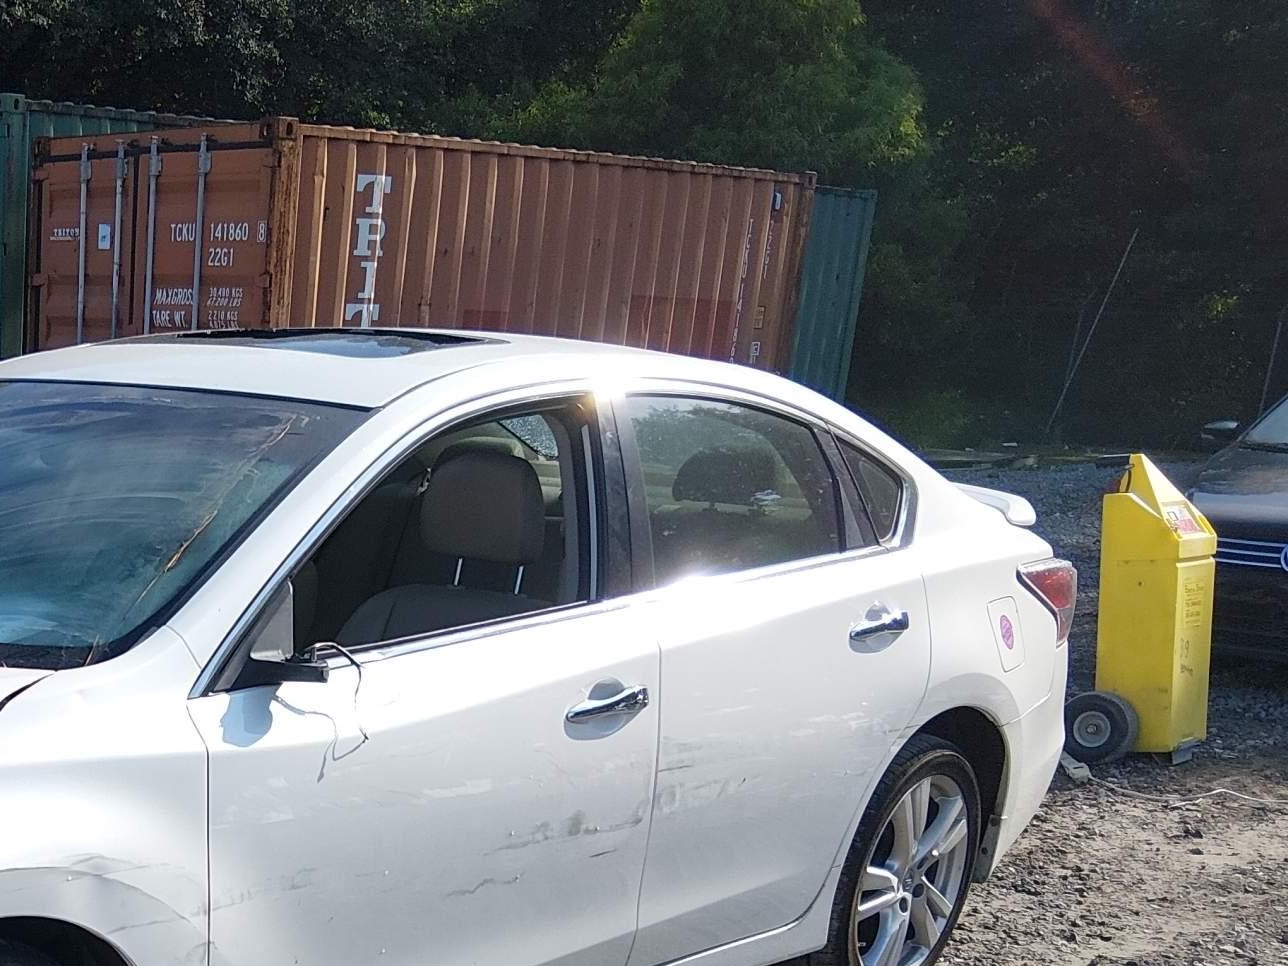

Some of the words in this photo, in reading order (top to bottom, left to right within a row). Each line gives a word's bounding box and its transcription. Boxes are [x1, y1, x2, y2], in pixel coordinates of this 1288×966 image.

[170, 223, 196, 242] TCKU
[210, 223, 249, 241] 141860
[258, 223, 266, 241] 8
[208, 247, 233, 266] 22G1
[153, 288, 194, 305] MAXGROS
[152, 311, 172, 328] TARE
